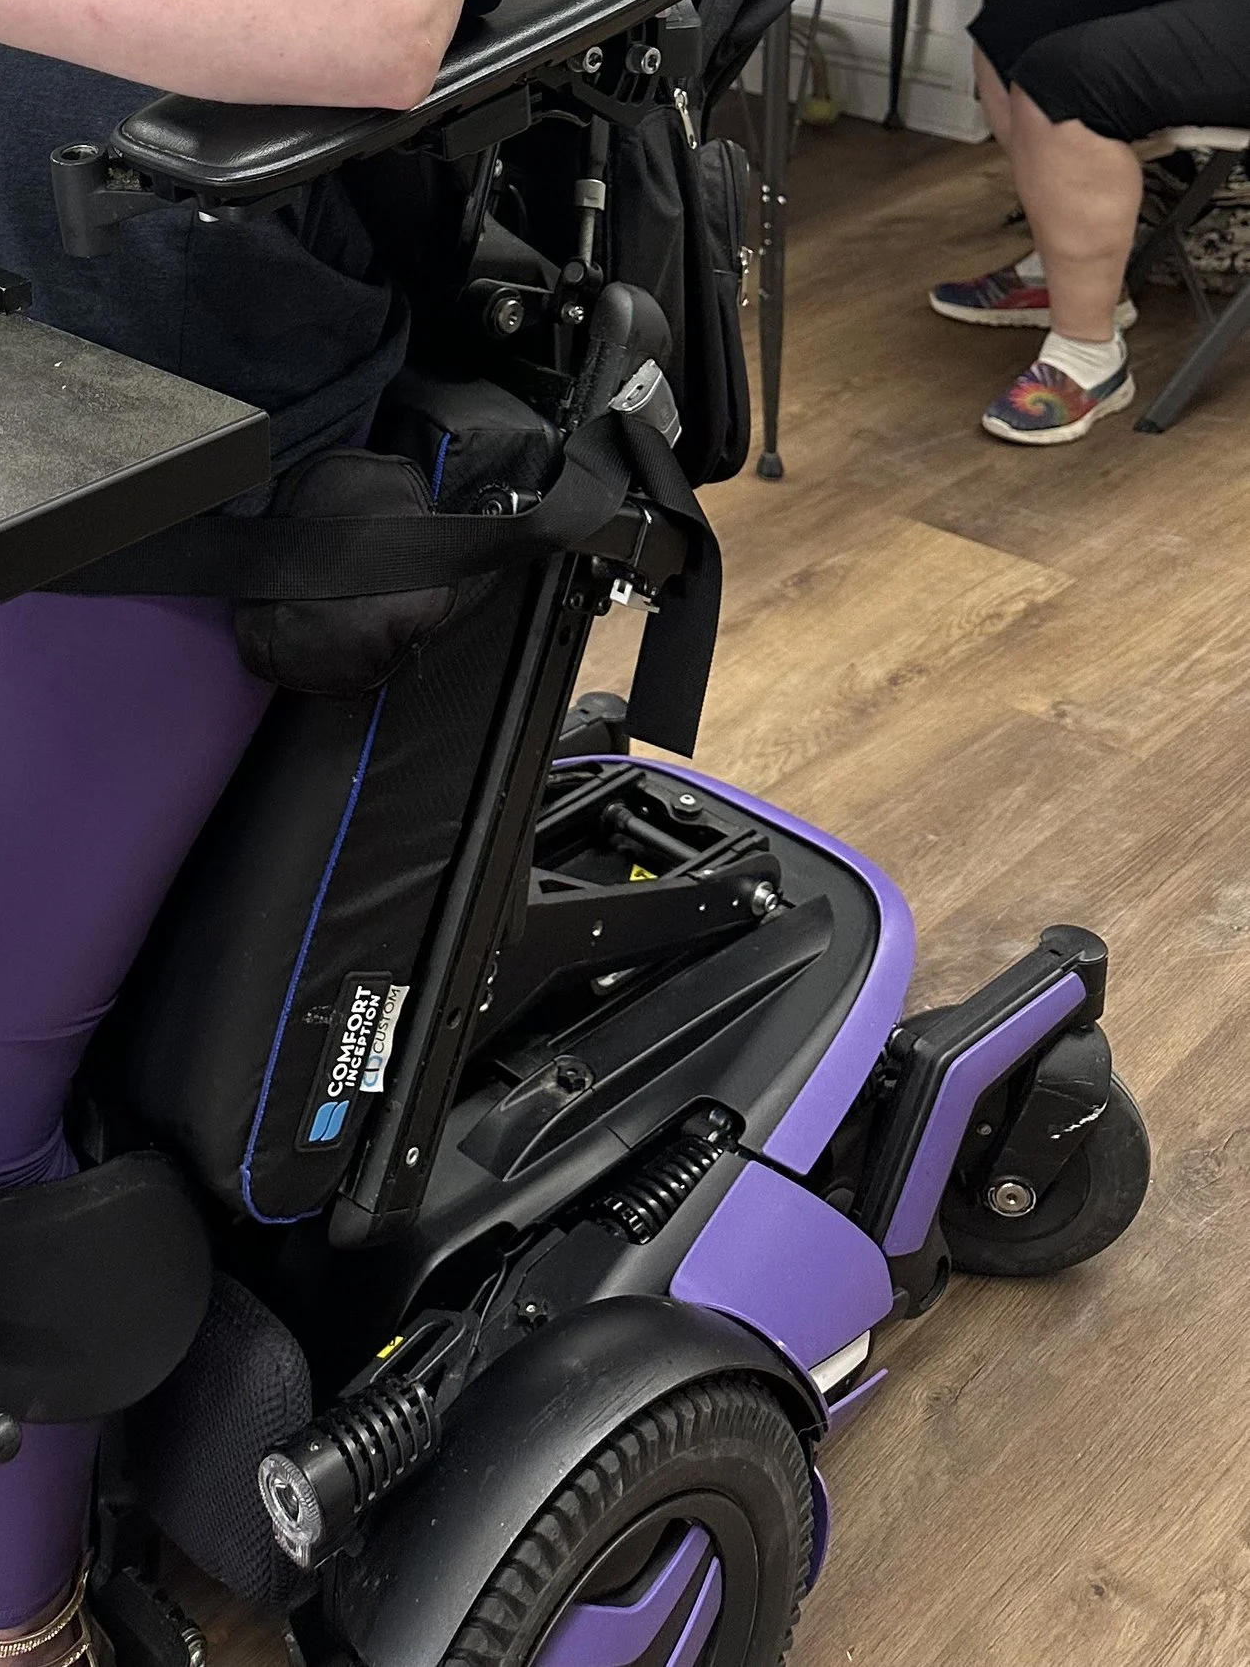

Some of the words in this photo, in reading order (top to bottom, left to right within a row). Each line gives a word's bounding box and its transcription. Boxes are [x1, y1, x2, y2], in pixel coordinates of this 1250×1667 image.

[327, 985, 372, 1097] COMFORT
[345, 994, 381, 1087] INCEPTION
[373, 988, 401, 1054] CUSTOM
